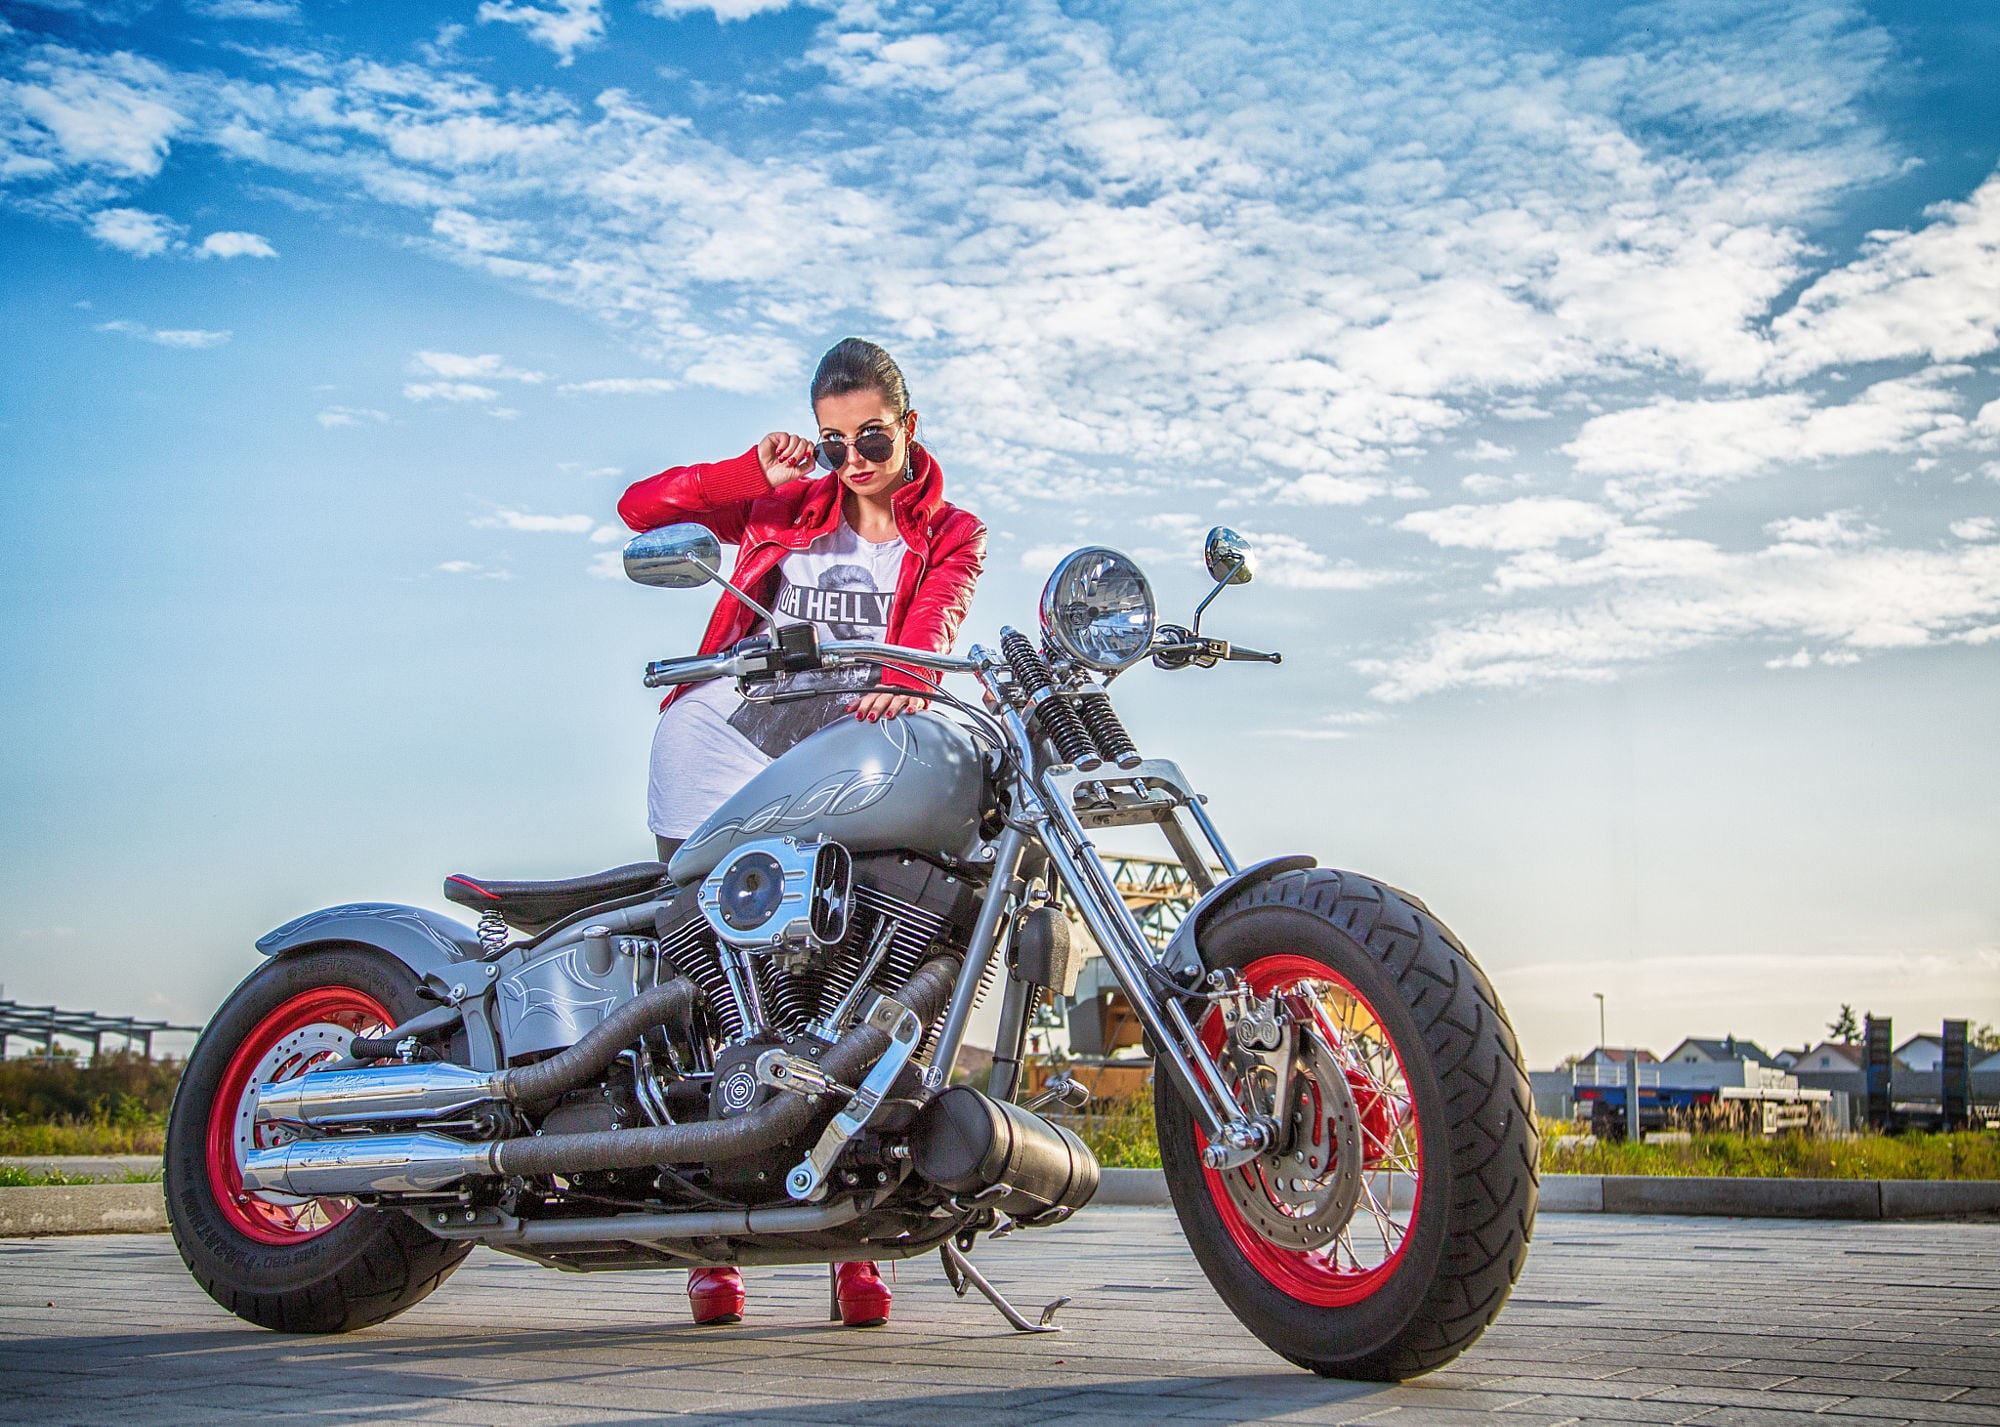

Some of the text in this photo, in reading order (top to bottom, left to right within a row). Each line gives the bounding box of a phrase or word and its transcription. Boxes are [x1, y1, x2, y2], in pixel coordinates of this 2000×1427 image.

[780, 583, 896, 625] OH HELL Y
